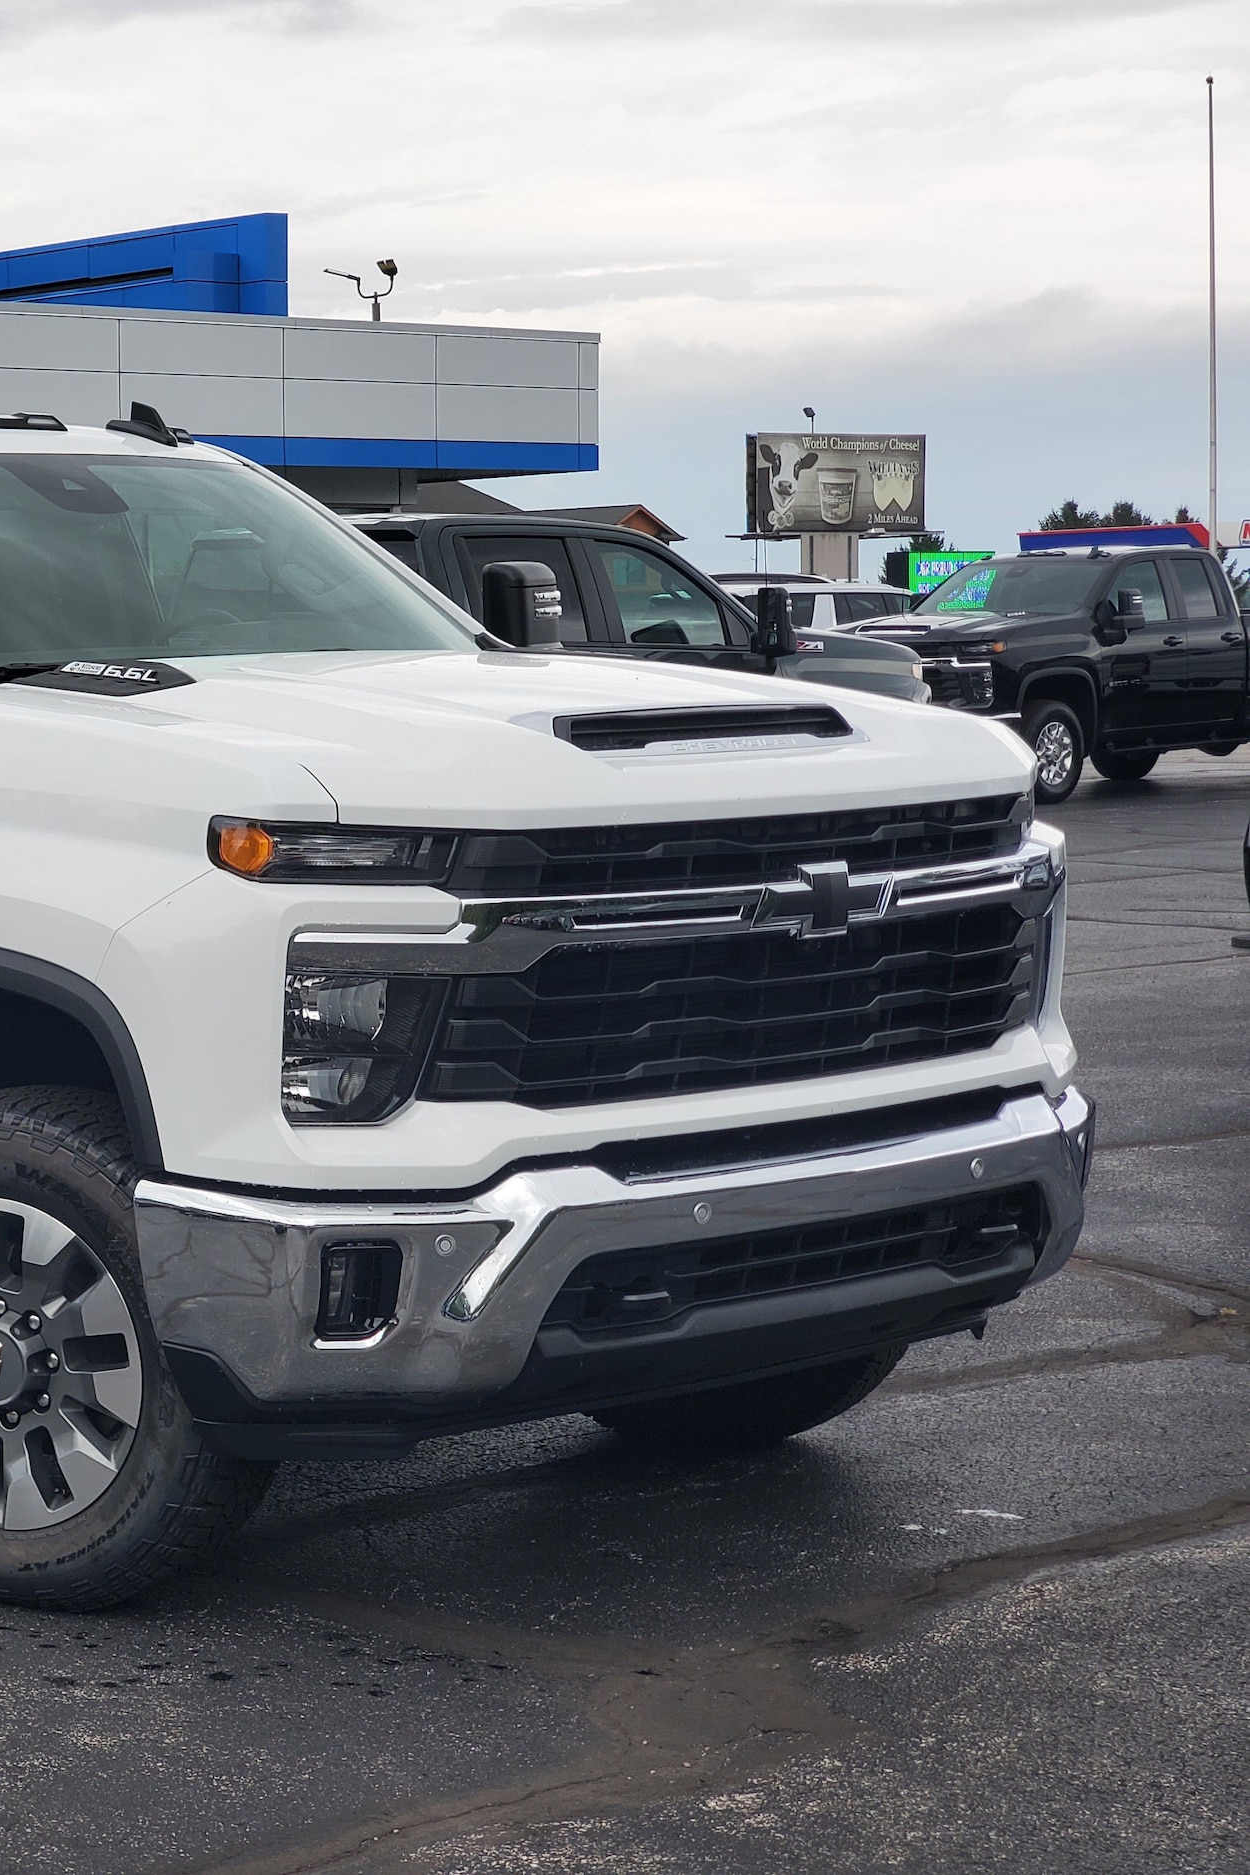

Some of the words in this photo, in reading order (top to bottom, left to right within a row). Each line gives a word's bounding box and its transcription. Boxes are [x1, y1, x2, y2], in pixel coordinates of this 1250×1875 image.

[802, 437, 828, 449] World
[830, 437, 879, 454] Champions
[879, 440, 888, 453] of
[890, 439, 920, 451] Cheese!
[867, 514, 872, 524] 2
[103, 665, 158, 682] 6.6L
[671, 737, 798, 751] CHEVROLET
